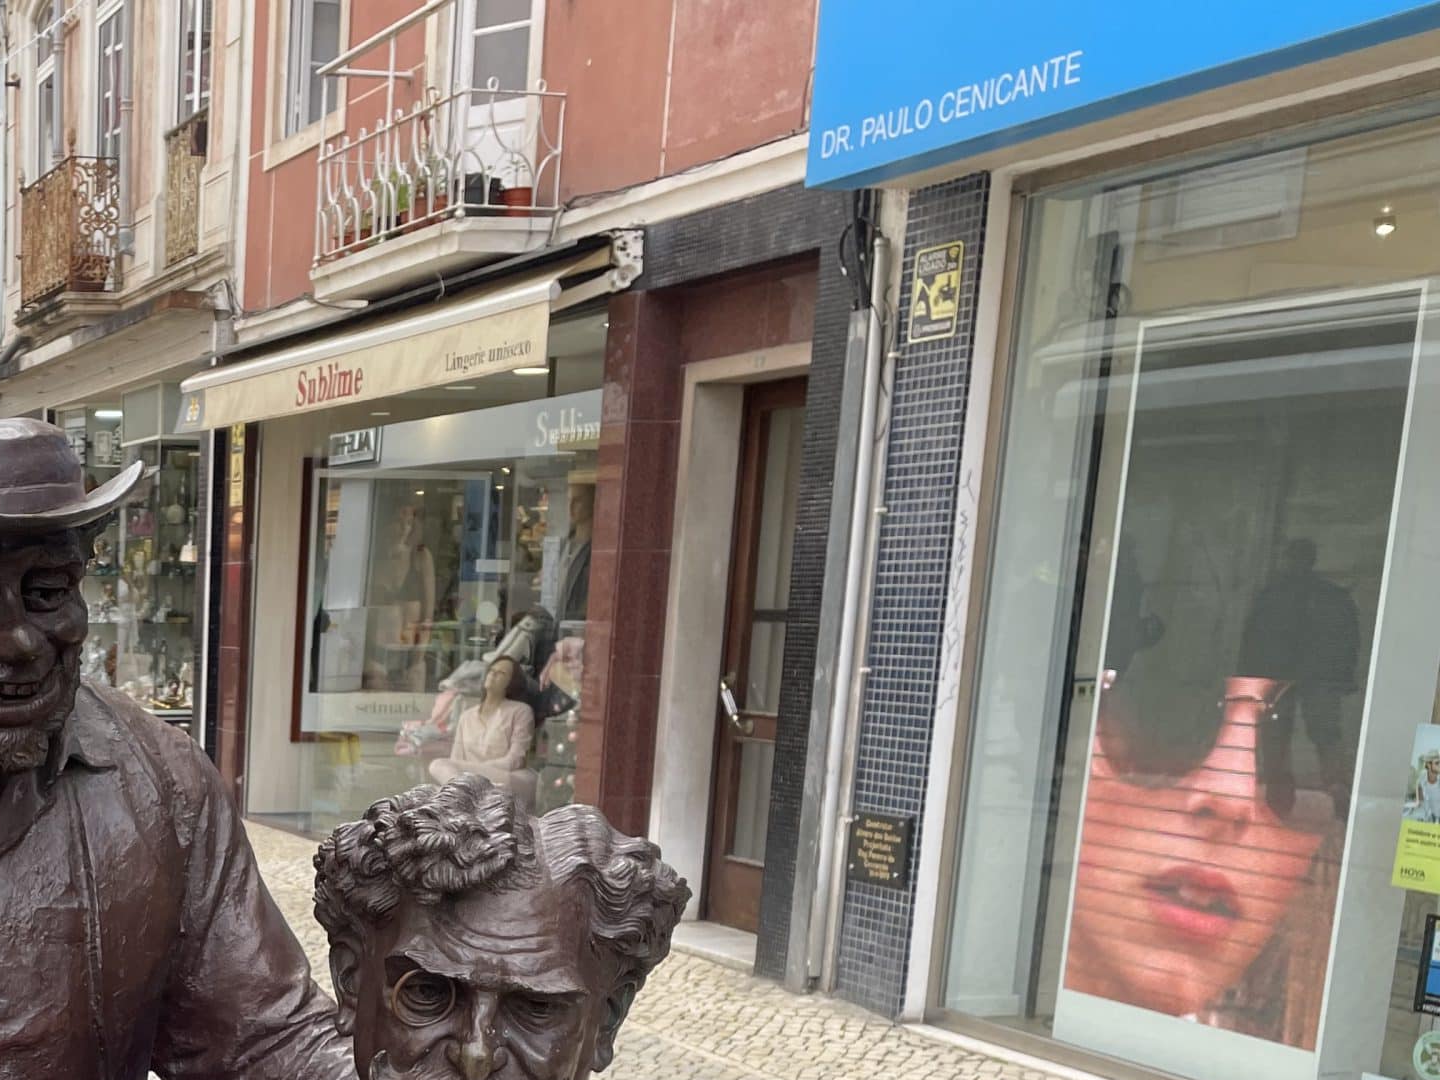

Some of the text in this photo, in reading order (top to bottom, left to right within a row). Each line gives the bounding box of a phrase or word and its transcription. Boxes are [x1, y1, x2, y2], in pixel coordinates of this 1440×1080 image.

[821, 50, 1084, 160] DR. PAULO CENICANTE
[445, 339, 532, 373] Lingerie unissexo
[294, 366, 364, 408] Sublime
[1400, 866, 1425, 880] HOYA
